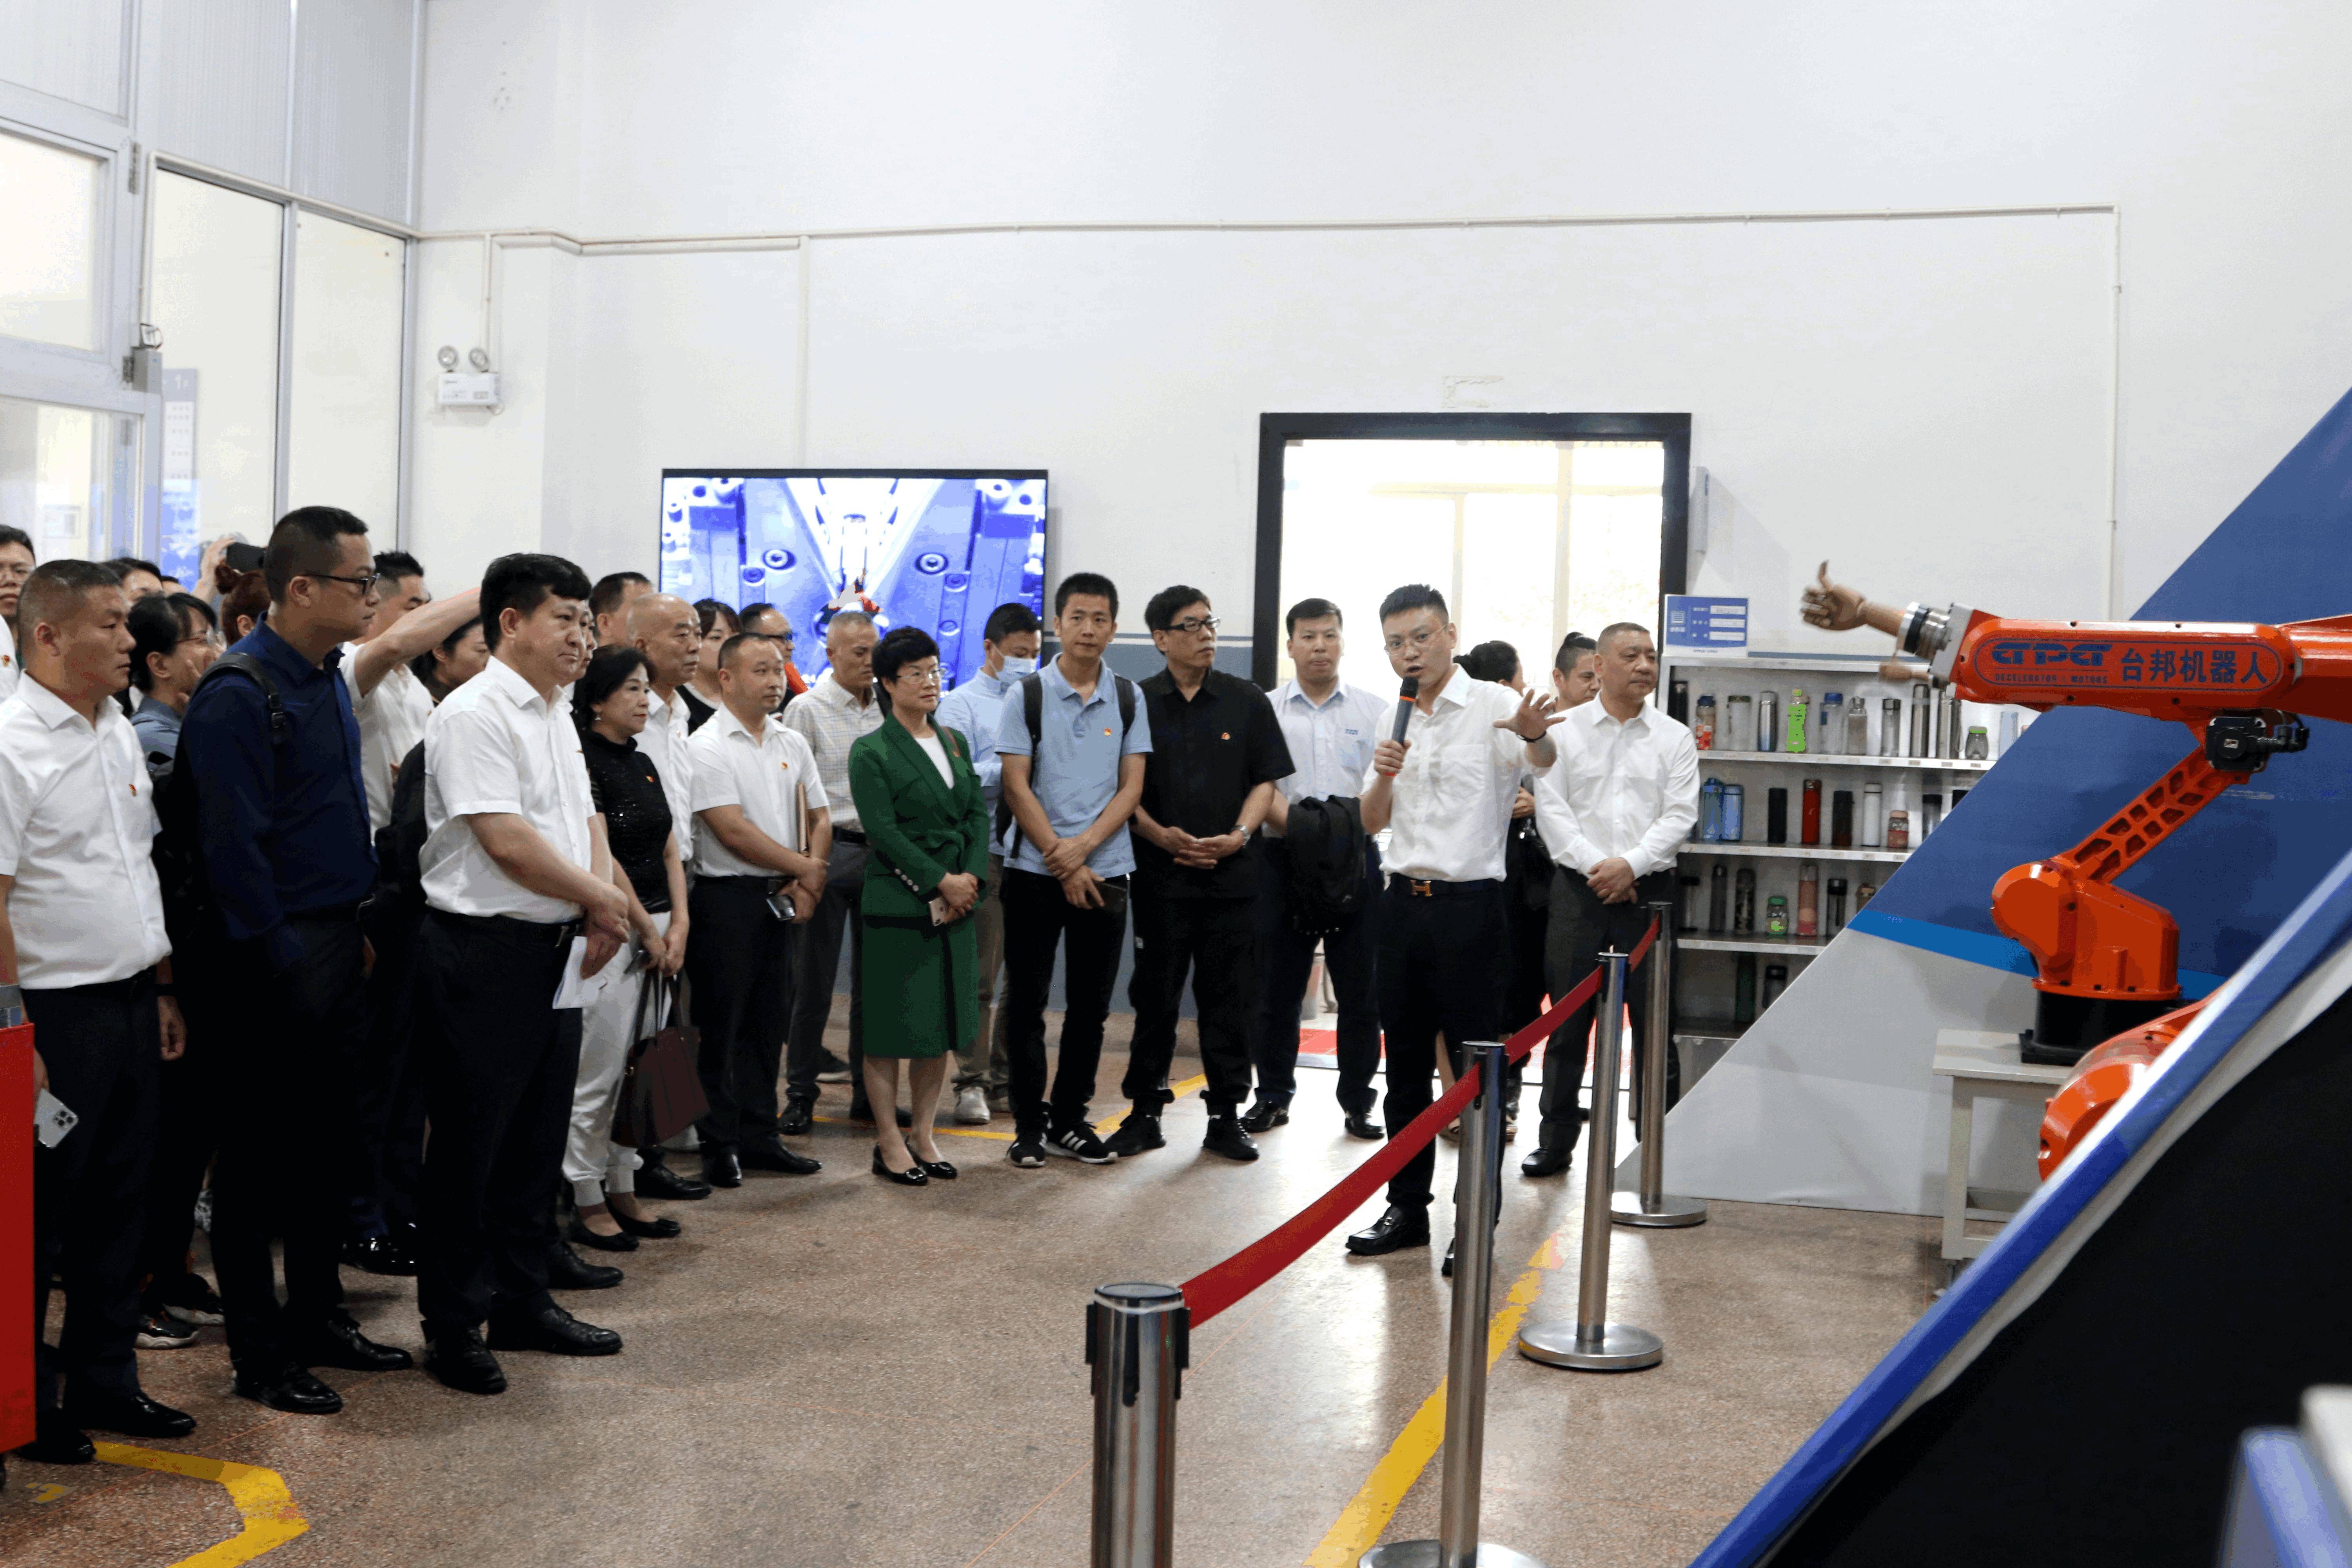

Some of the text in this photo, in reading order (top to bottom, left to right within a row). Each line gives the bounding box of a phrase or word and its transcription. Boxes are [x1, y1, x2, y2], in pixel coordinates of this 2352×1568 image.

[2121, 648, 2267, 683] 台邦机器人
